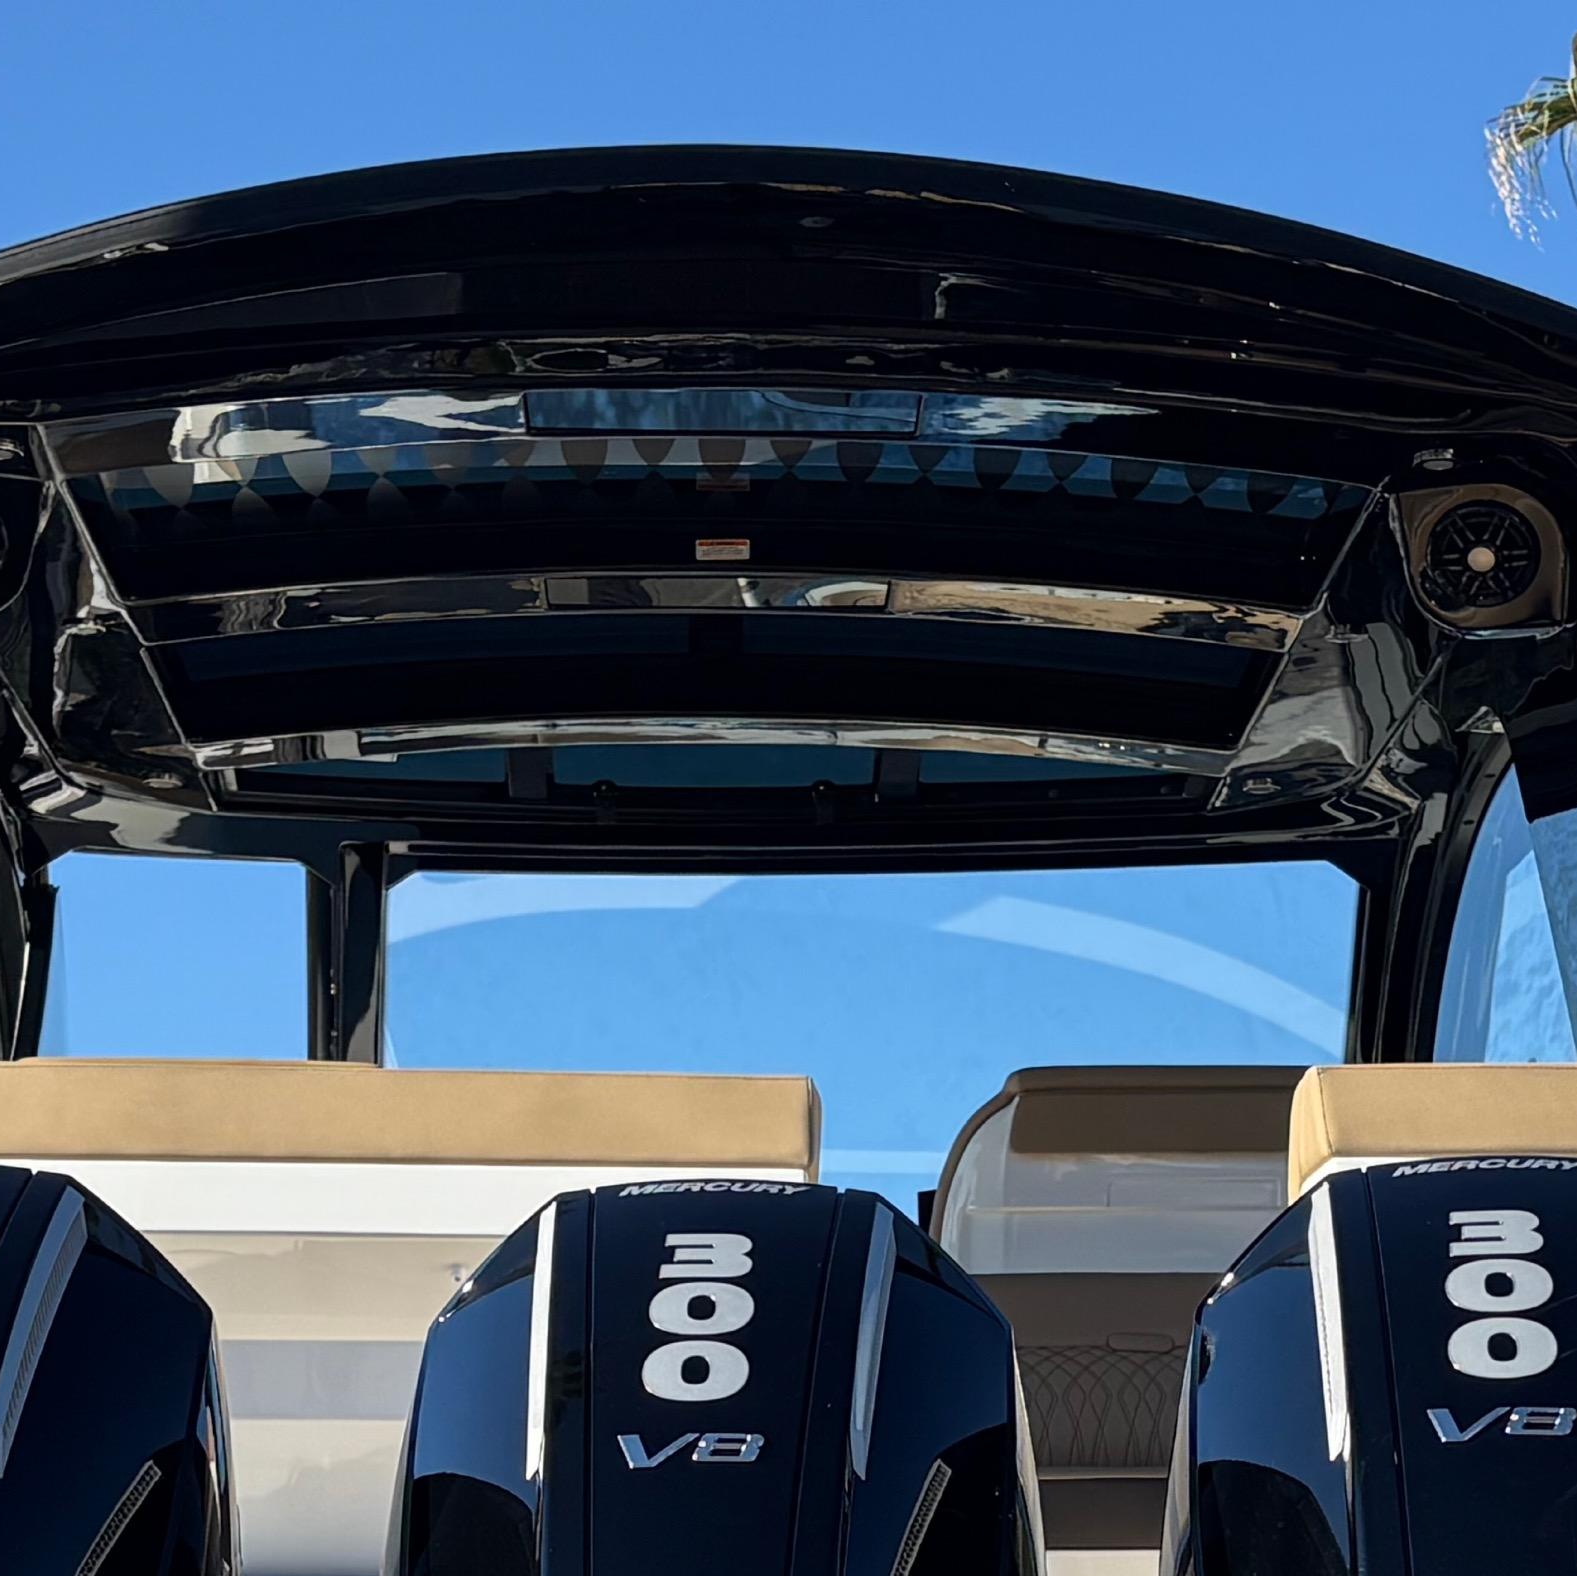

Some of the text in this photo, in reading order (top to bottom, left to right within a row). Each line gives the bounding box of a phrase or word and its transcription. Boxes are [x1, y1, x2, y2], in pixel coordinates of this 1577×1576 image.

[618, 1180, 812, 1198] MERCURY
[1444, 1209, 1558, 1379] 300
[641, 1232, 755, 1402] 300
[1426, 1404, 1577, 1443] V8
[617, 1431, 765, 1469] V8
